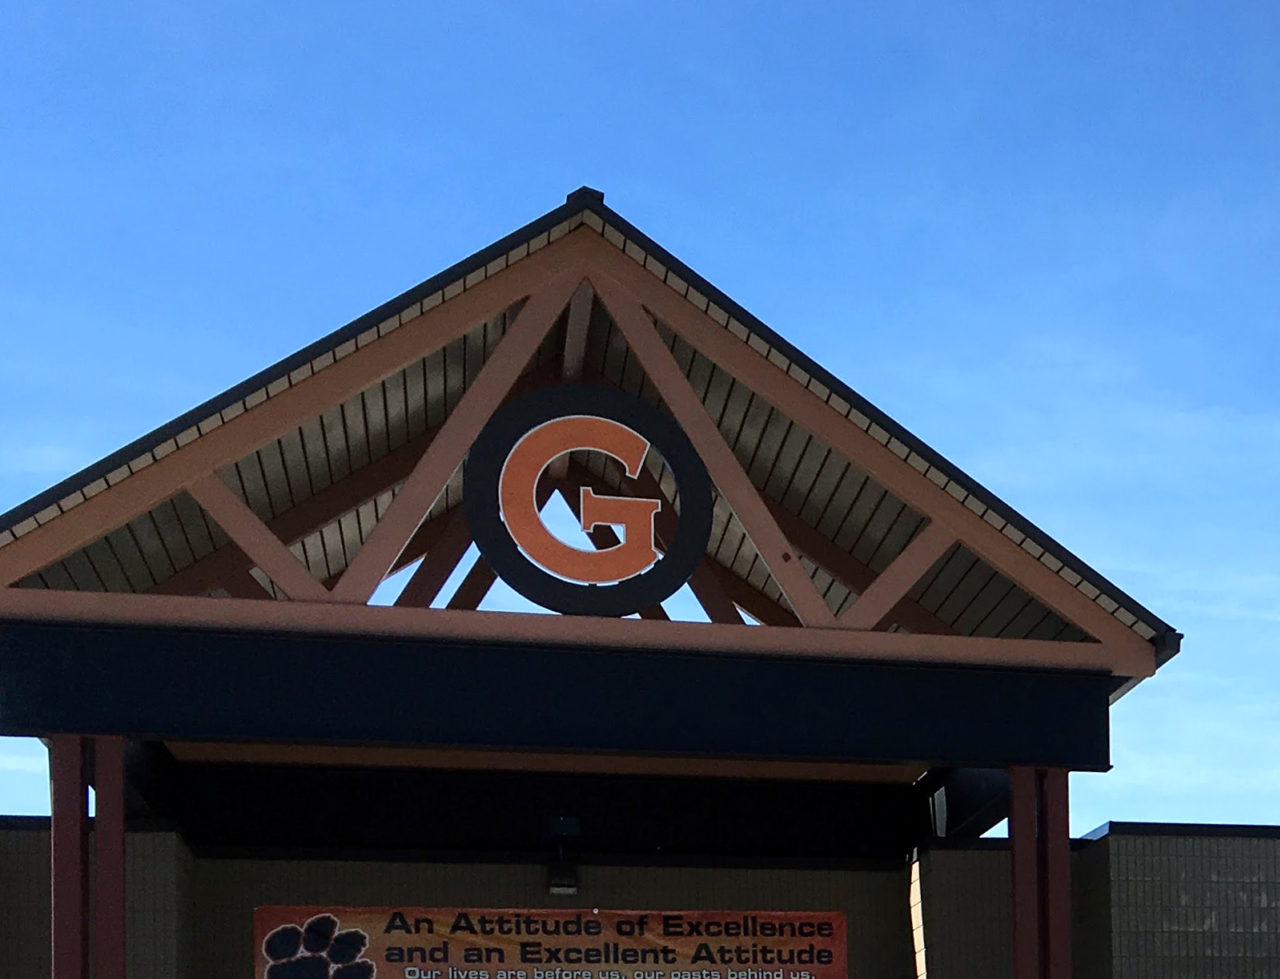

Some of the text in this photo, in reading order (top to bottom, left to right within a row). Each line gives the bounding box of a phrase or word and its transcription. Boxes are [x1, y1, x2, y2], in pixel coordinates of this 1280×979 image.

[498, 414, 662, 586] G
[383, 911, 833, 938] An Attitude of Excellence
[385, 941, 833, 965] and an Excellent Attitude
[405, 967, 440, 979] Our
[448, 967, 489, 979] lives
[496, 970, 527, 979] are
[533, 967, 592, 979] before
[633, 970, 665, 979] our
[727, 968, 783, 979] behind
